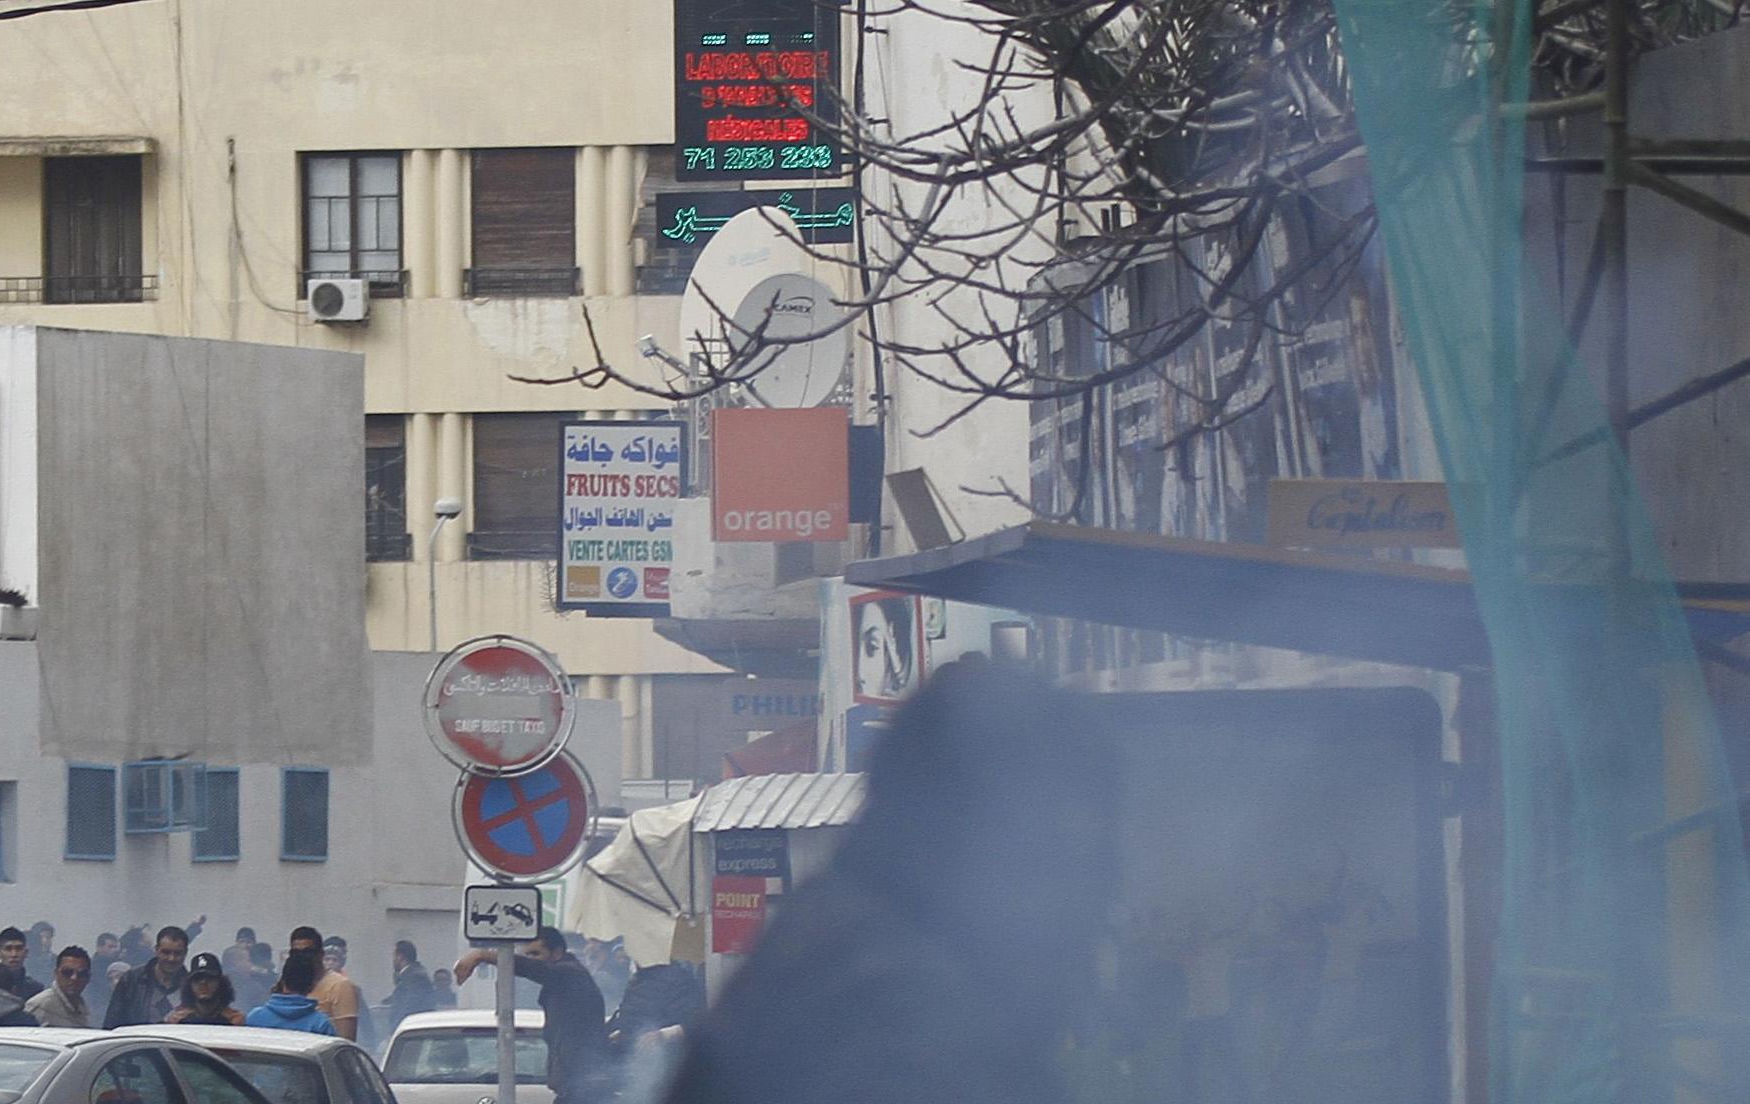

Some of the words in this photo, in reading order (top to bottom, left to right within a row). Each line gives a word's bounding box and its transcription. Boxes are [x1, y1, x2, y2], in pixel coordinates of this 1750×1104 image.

[683, 147, 715, 170] 71
[566, 435, 614, 468] جافة
[620, 436, 680, 469] فواكه
[566, 474, 631, 497] FRUITS
[635, 475, 680, 498] SECS
[564, 506, 603, 532] الجوال
[724, 509, 832, 537] orange
[568, 539, 604, 562] VENTE
[606, 540, 649, 562] CARTES
[717, 858, 777, 873] express
[716, 892, 761, 908] POINT
